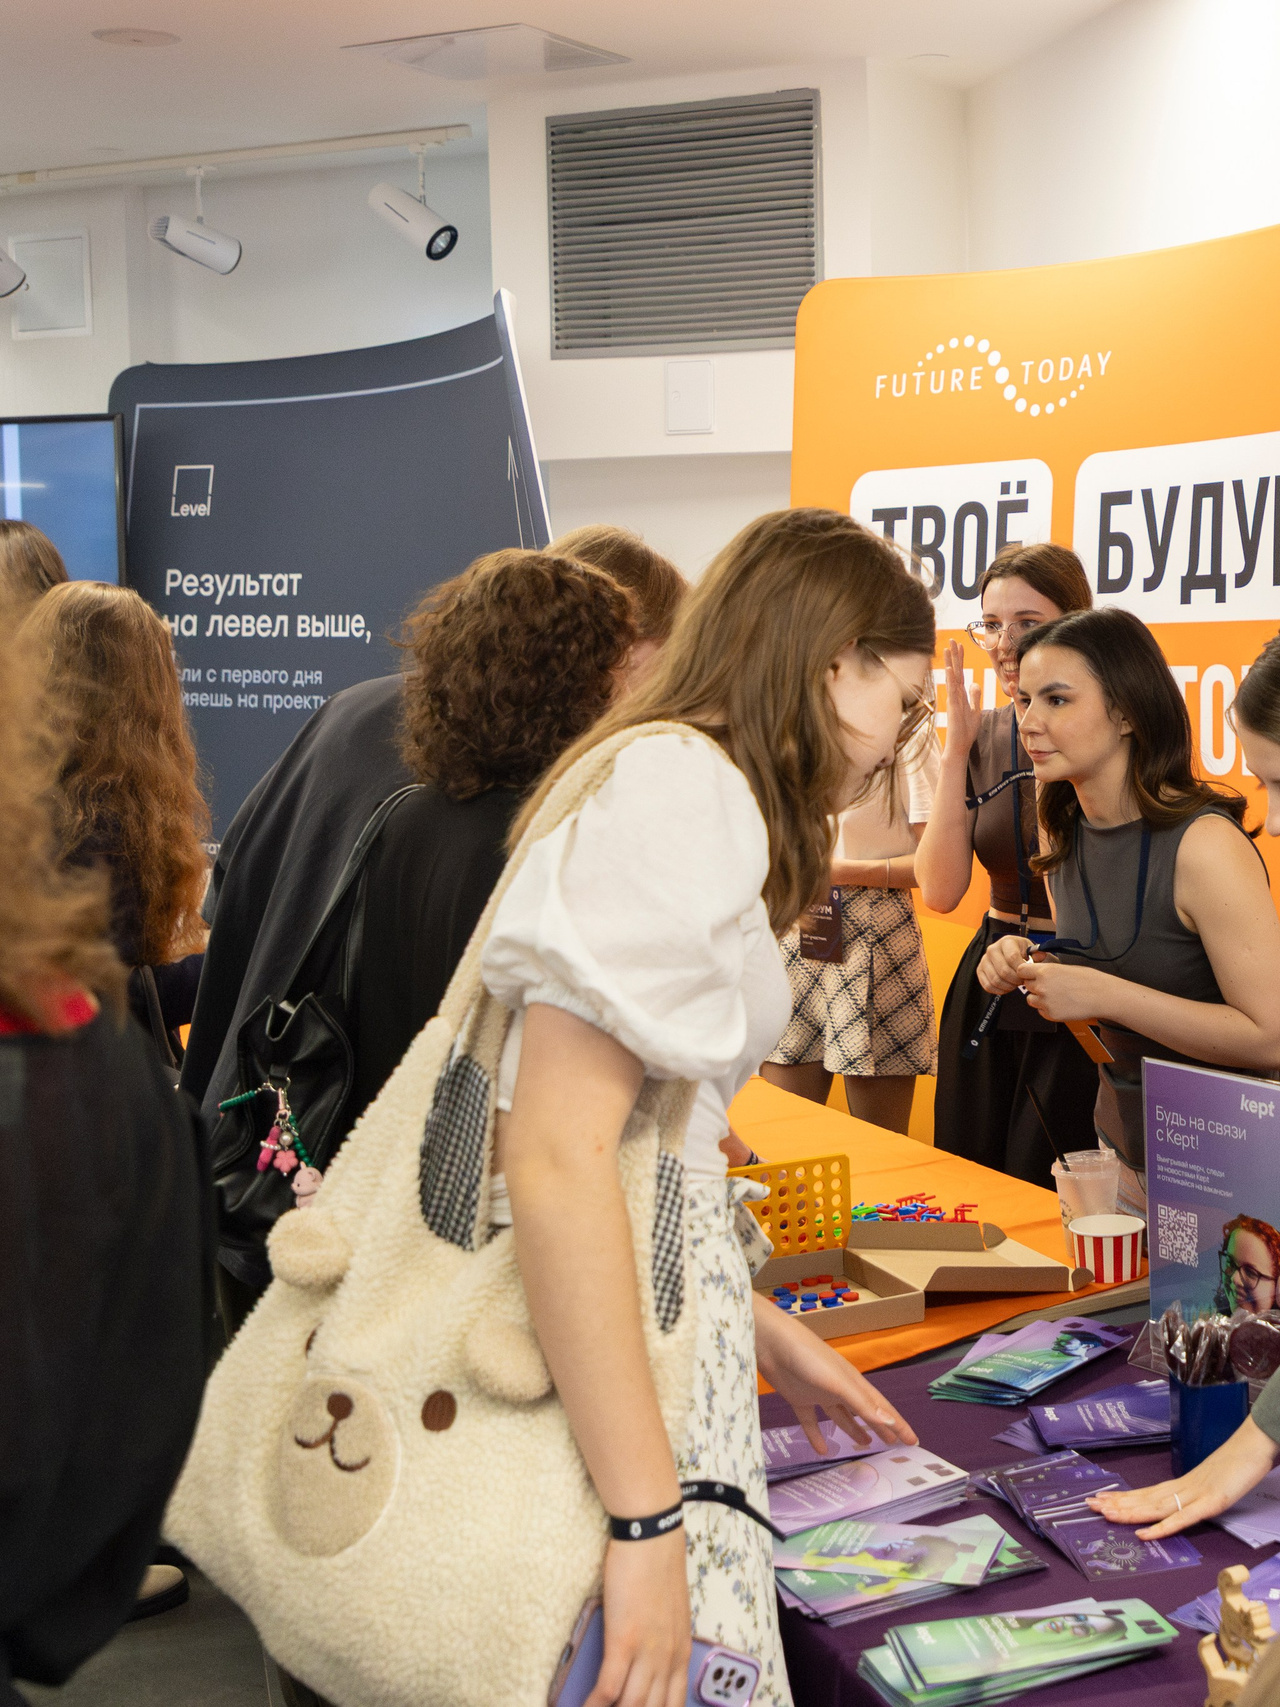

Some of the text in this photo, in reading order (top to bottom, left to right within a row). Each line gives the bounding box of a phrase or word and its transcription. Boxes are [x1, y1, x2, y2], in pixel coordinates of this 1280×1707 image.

[875, 350, 1112, 399] FUTURE TODAY
[171, 496, 211, 517] Level
[165, 568, 302, 605] Результат
[205, 614, 289, 637] левел
[296, 613, 371, 644] выше,
[206, 668, 217, 682] с
[221, 669, 289, 688] первого
[292, 669, 323, 687] дня
[237, 693, 258, 708] на
[1240, 1094, 1275, 1119] kept
[1155, 1105, 1247, 1140] Будь на связи
[1166, 1127, 1199, 1151] Kept!
